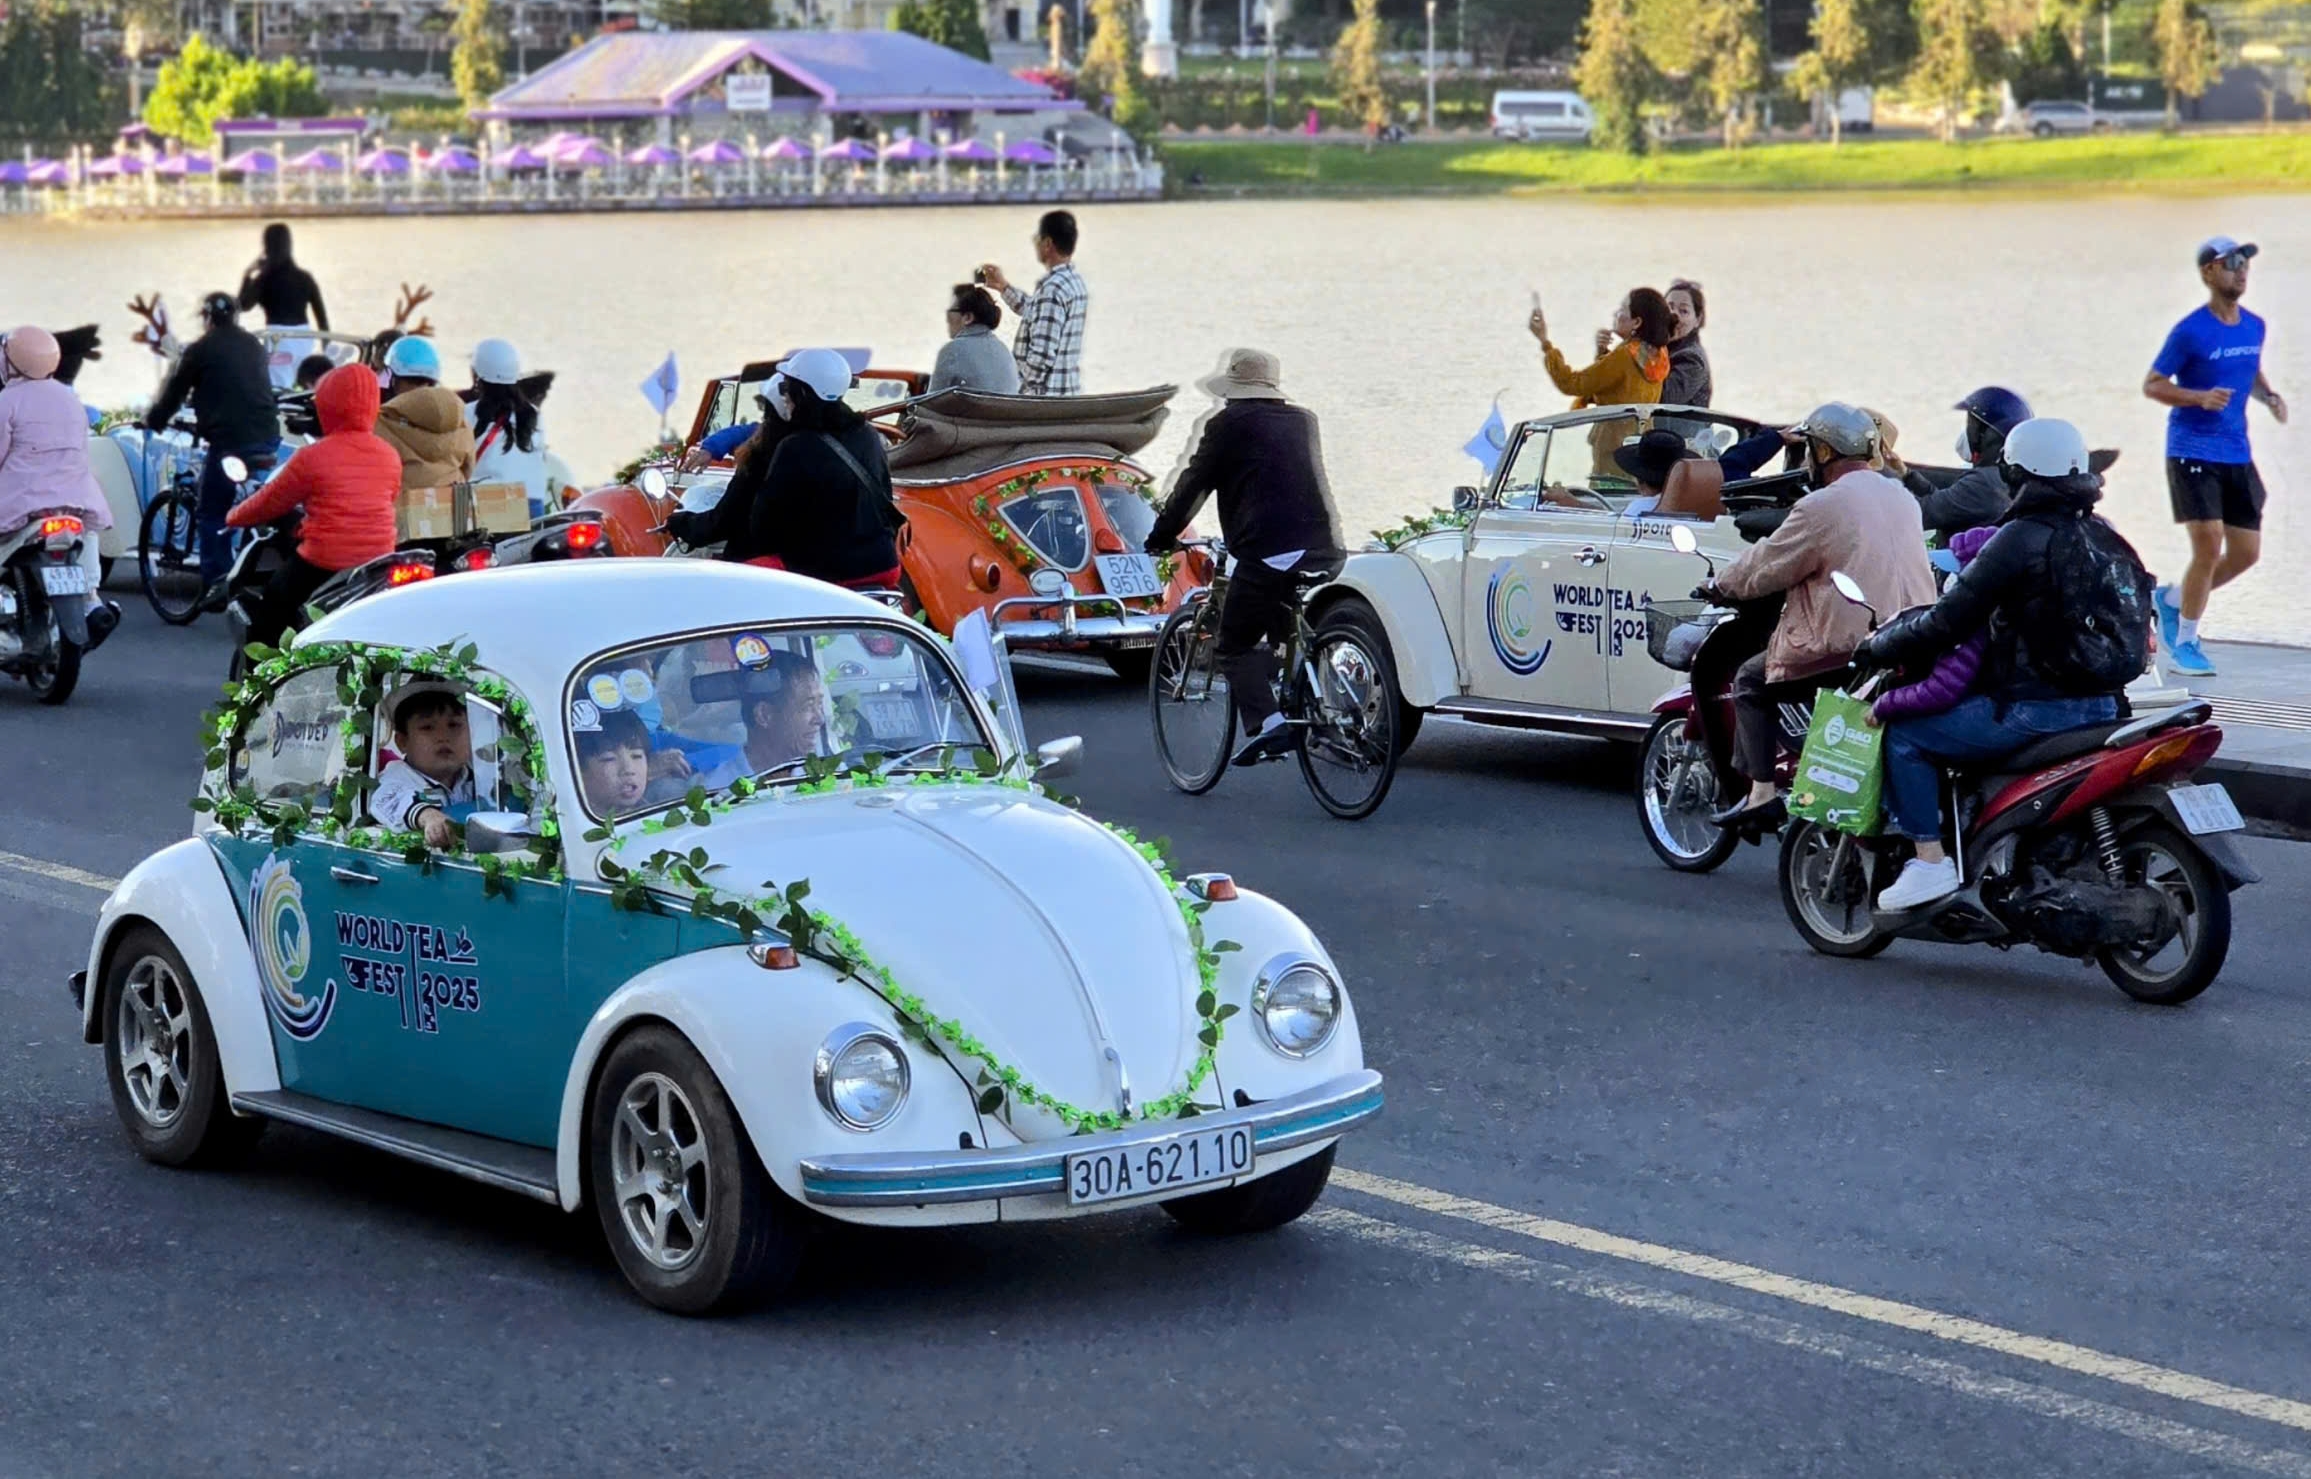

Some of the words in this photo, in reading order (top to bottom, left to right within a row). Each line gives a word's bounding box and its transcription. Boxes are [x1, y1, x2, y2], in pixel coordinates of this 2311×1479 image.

[1107, 555, 1144, 575] 52N
[1110, 574, 1155, 595] 9516
[1553, 583, 1604, 607] WORLD
[1556, 611, 1602, 655] FEST
[334, 910, 406, 954] WORLD
[340, 953, 406, 1029] FEST
[421, 971, 480, 1034] 2025
[1074, 1130, 1248, 1199] 30A-621.10
